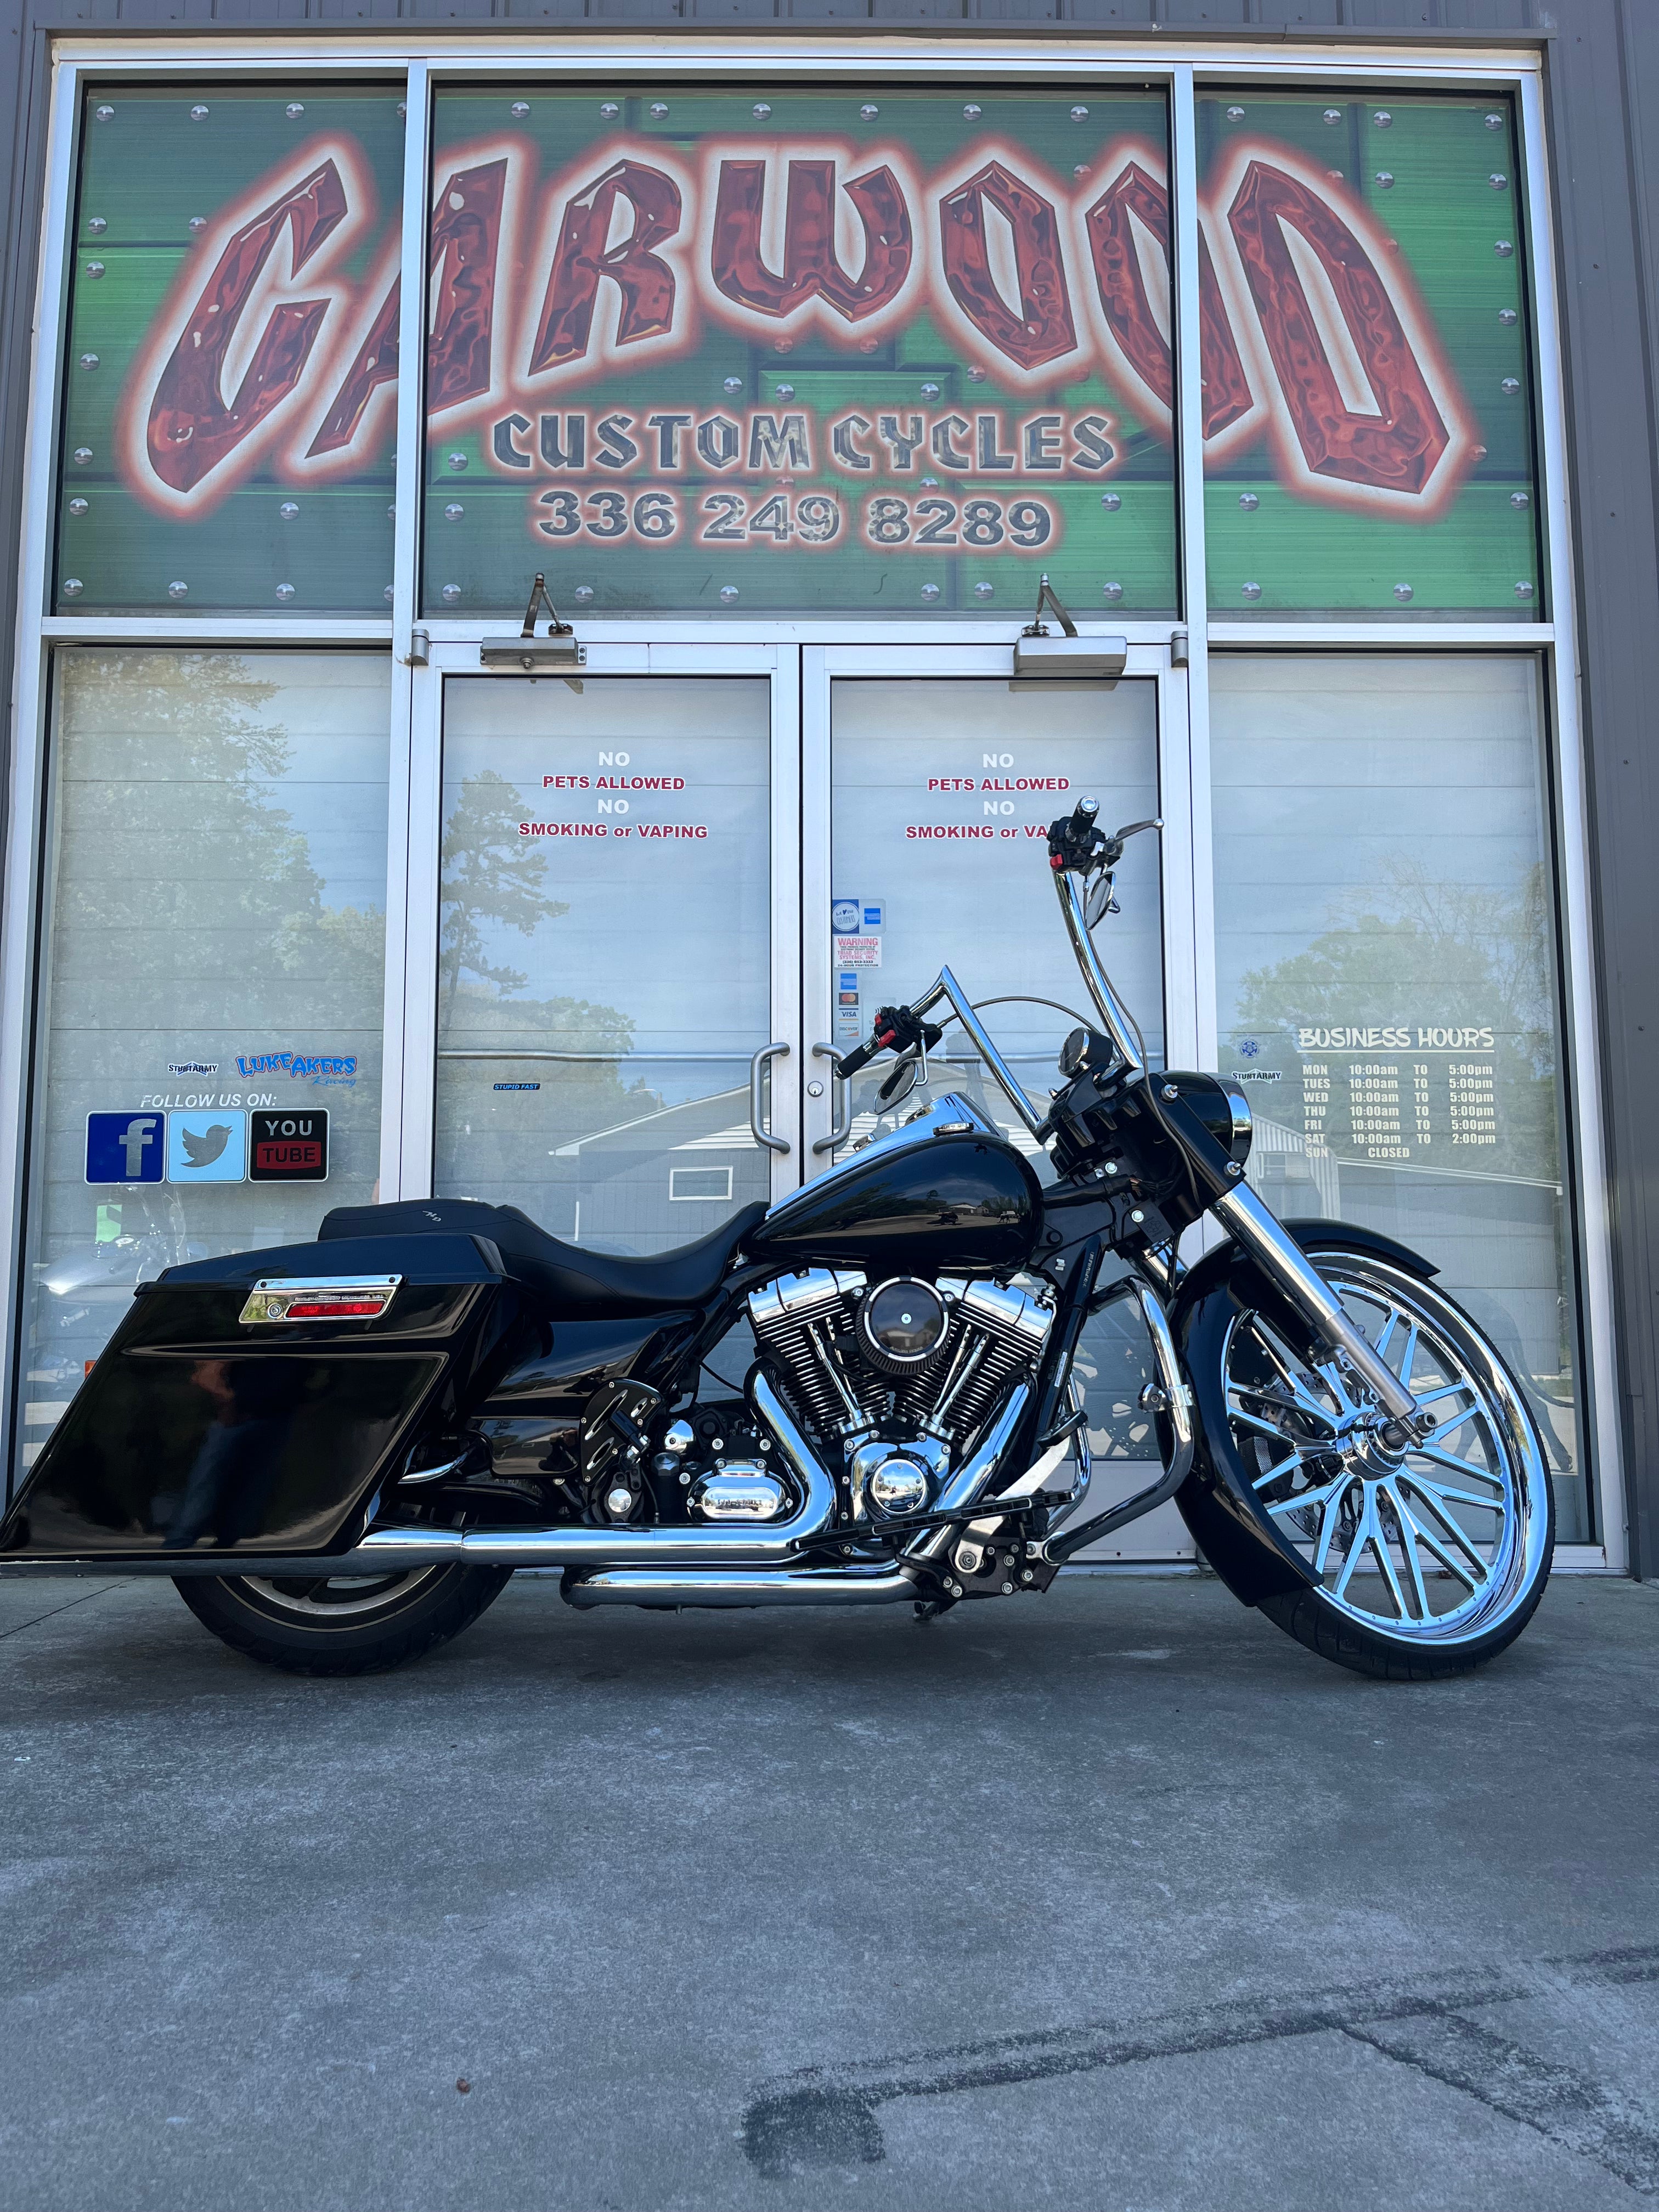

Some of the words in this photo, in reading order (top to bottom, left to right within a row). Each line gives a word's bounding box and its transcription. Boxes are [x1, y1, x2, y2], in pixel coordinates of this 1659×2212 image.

[146, 156, 1449, 495] GARWOOD
[492, 413, 810, 470] CUSTOM
[833, 414, 1115, 470] CYCLES
[538, 490, 677, 538] 336
[702, 494, 840, 543] 249
[867, 498, 1051, 546] 8289
[599, 752, 630, 766] NO
[983, 753, 1014, 768] NO
[543, 776, 590, 789] PETS
[596, 776, 685, 790] ALLOWED
[928, 778, 975, 791] PETS
[981, 778, 1069, 791] ALLOWED
[597, 799, 629, 814] NO
[983, 801, 1014, 815] NO
[518, 823, 608, 837] SMOKING
[613, 827, 632, 837] or
[637, 825, 708, 839] VAPING
[906, 826, 994, 838] SMOKING
[1000, 828, 1018, 838] or
[1298, 1028, 1411, 1047] BUSINESS
[1418, 1028, 1494, 1047] HOURS
[1302, 1065, 1328, 1075] MON
[1349, 1065, 1398, 1075] 10:00am
[1414, 1065, 1427, 1075] TO
[1449, 1065, 1493, 1077] 5:00pm
[312, 1075, 357, 1087] Racing
[1303, 1079, 1330, 1089] TUES
[1349, 1079, 1398, 1089] 10:00am
[1414, 1079, 1427, 1089] TO
[1449, 1079, 1493, 1091] 5:00pm
[140, 1094, 216, 1108] FOLLOW
[219, 1093, 241, 1107] US
[247, 1093, 277, 1107] ON:
[1304, 1092, 1329, 1103] WED
[1350, 1092, 1399, 1103] 10:00am
[1414, 1092, 1428, 1103] TO
[1450, 1092, 1494, 1104] 5:00pm
[1304, 1106, 1326, 1116] THU
[1350, 1106, 1399, 1116] 10:00am
[1414, 1106, 1429, 1116] TO
[1450, 1106, 1494, 1118] 5:00pm
[265, 1120, 312, 1136] YOU
[1305, 1120, 1322, 1130] FRI
[1351, 1120, 1400, 1130] 10:00am
[1416, 1120, 1430, 1130] TO
[1451, 1120, 1495, 1132] 5:00pm
[1305, 1133, 1325, 1144] SAT
[1352, 1133, 1401, 1144] 10:00am
[1417, 1133, 1431, 1144] TO
[1452, 1133, 1496, 1146] 2:00pm
[262, 1147, 315, 1163] TUBE
[1305, 1148, 1328, 1158] SUN
[1368, 1148, 1410, 1158] CLOSED
